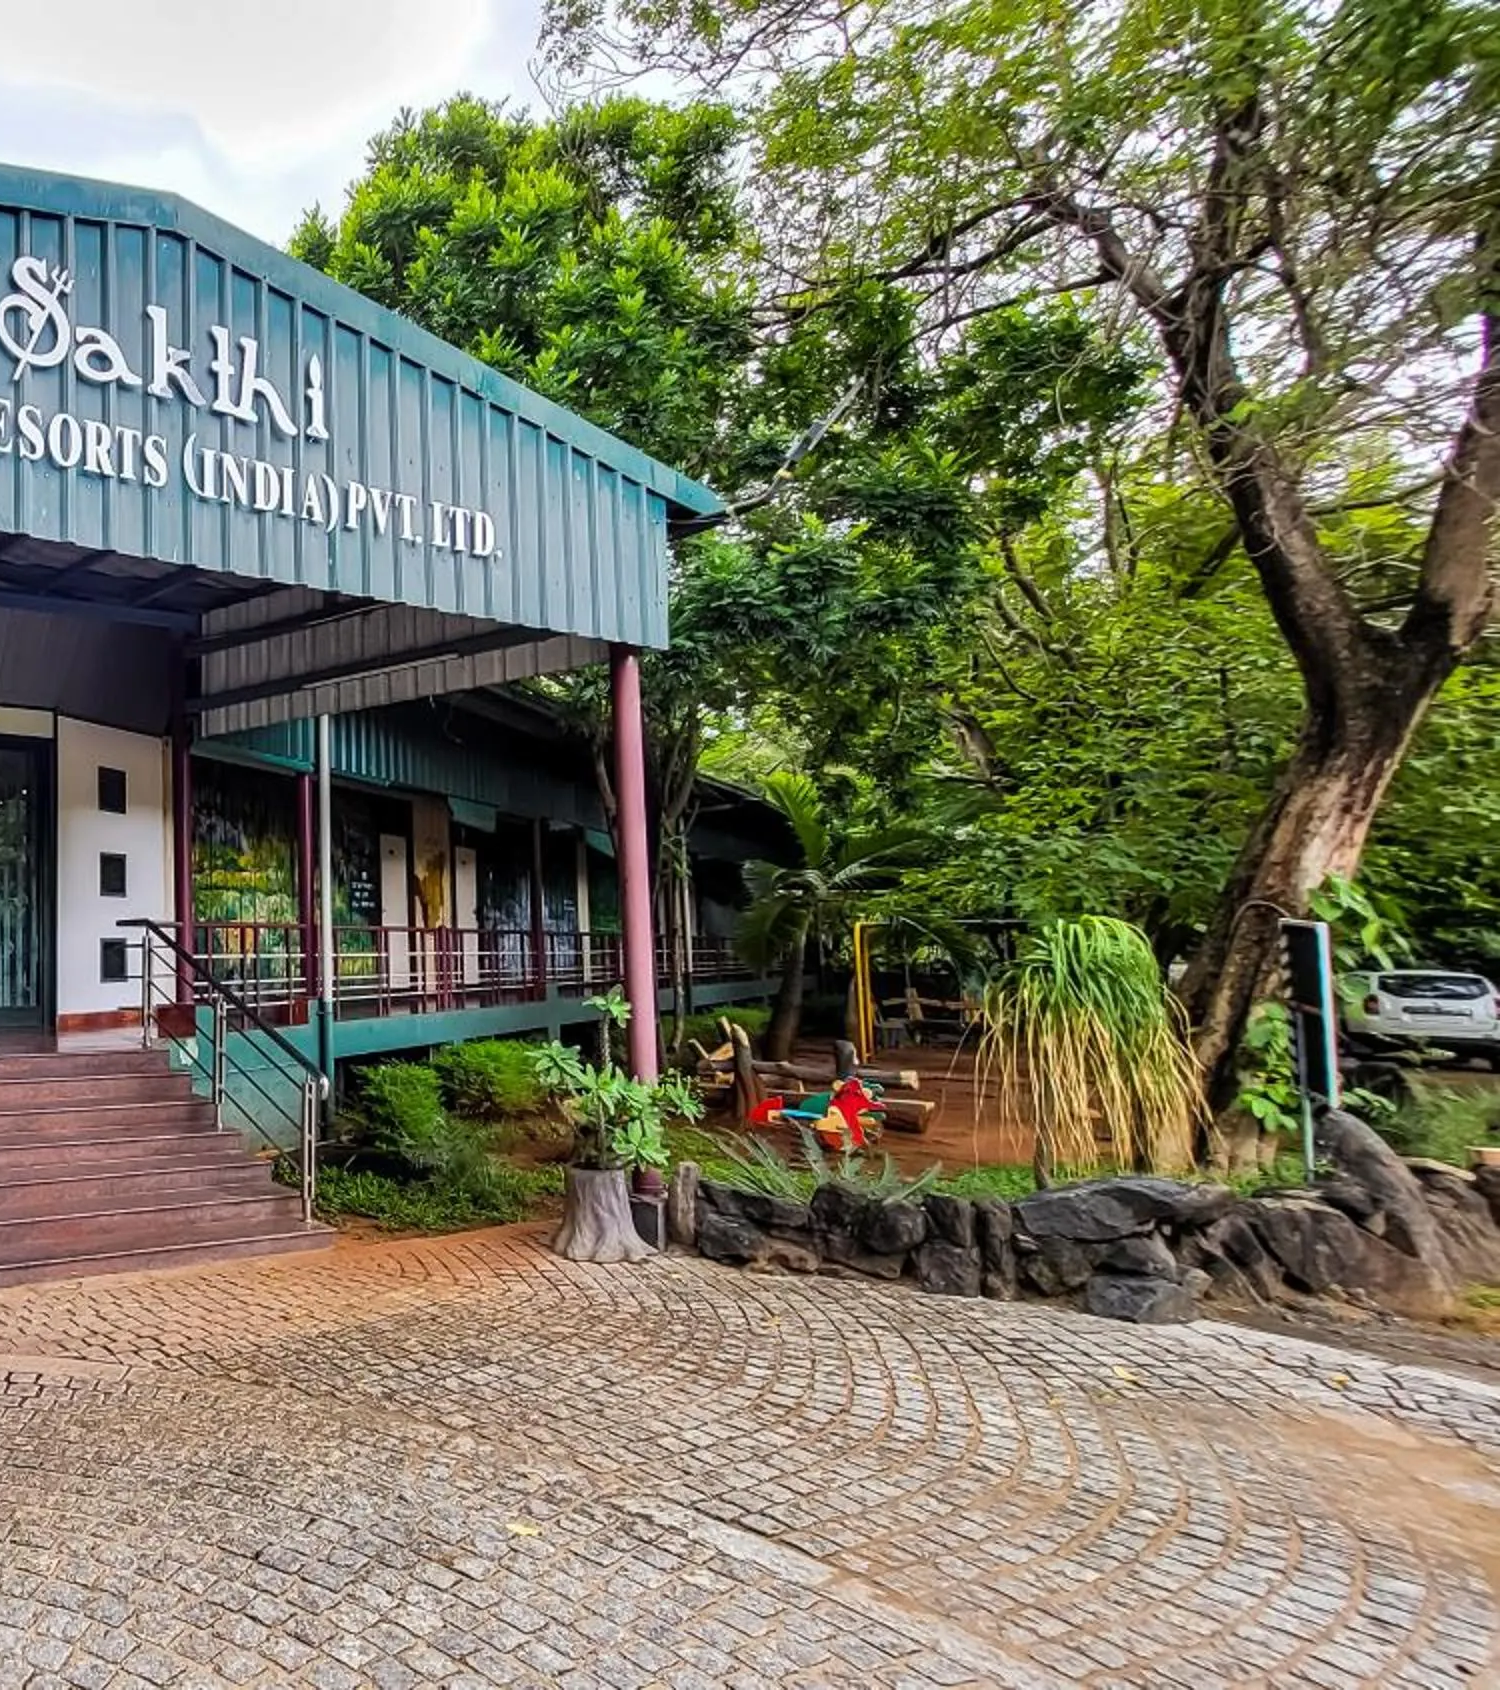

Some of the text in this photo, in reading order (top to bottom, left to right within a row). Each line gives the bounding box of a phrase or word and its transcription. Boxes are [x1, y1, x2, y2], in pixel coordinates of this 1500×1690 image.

[184, 433, 339, 533] (INDIA)
[345, 480, 424, 543] PVT.
[428, 501, 503, 559] LTD.
